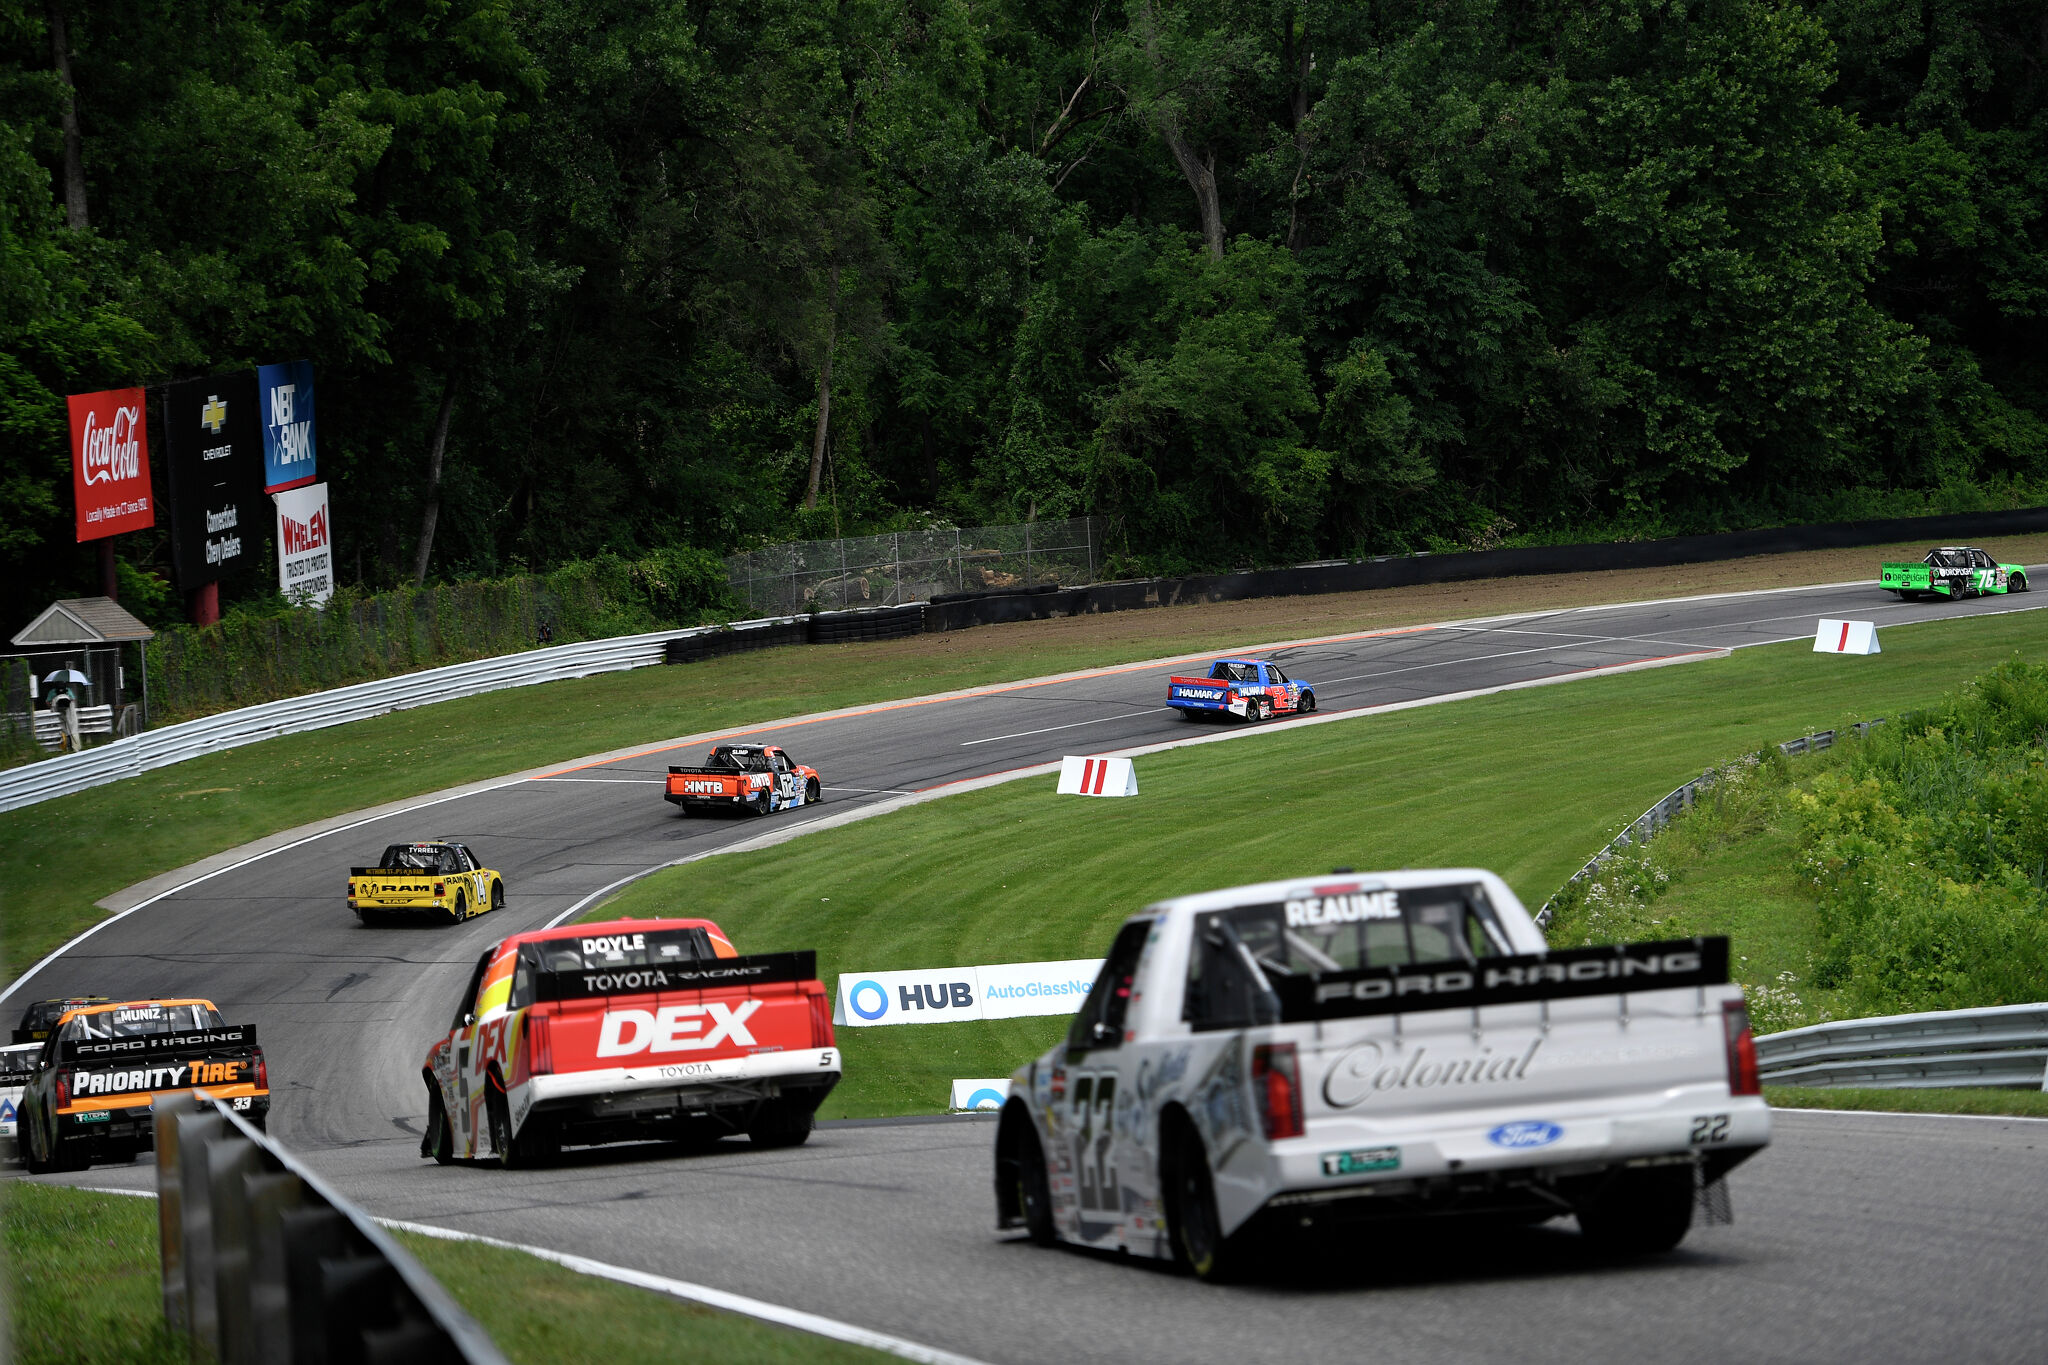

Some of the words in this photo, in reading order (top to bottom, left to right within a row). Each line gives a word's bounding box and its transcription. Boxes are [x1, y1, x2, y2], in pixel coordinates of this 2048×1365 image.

[271, 384, 295, 426] NBT
[83, 406, 139, 486] Coca-Cola
[203, 444, 231, 460] CHEVROLET
[281, 420, 311, 465] BANK
[86, 509, 103, 522] Locally
[103, 505, 115, 519] Made
[207, 503, 237, 533] Connecticut
[281, 504, 327, 556] WHELEN
[206, 539, 222, 567] Chevy
[222, 532, 241, 560] Dealers
[286, 559, 304, 579] TRUSTED
[305, 557, 310, 574] TO
[311, 552, 328, 572] PROTECT
[1979, 569, 1995, 588] 76
[1179, 688, 1212, 698] HALMAR
[1271, 686, 1288, 708] 52
[684, 780, 723, 794] HNTB
[749, 774, 770, 788] HNTB
[780, 774, 796, 798] 62
[446, 876, 464, 885] RAM
[1286, 892, 1401, 927] REAUME
[582, 934, 646, 954] DOYLE
[584, 970, 669, 992] TOYOTA
[1316, 969, 1474, 1003] FORD
[1484, 950, 1702, 988] RACING
[899, 982, 973, 1011] HUB
[120, 1008, 160, 1022] MUNIZ
[596, 999, 764, 1058] DEX
[77, 1041, 146, 1055] FORD
[151, 1032, 244, 1049] RACING
[474, 1015, 509, 1077] DEX
[658, 1062, 713, 1079] TOYOTA
[819, 1052, 832, 1067] 5
[72, 1065, 187, 1096] PRIORITY
[1322, 1038, 1544, 1109] Colonial
[233, 1096, 251, 1112] 33
[1690, 1114, 1731, 1145] 22
